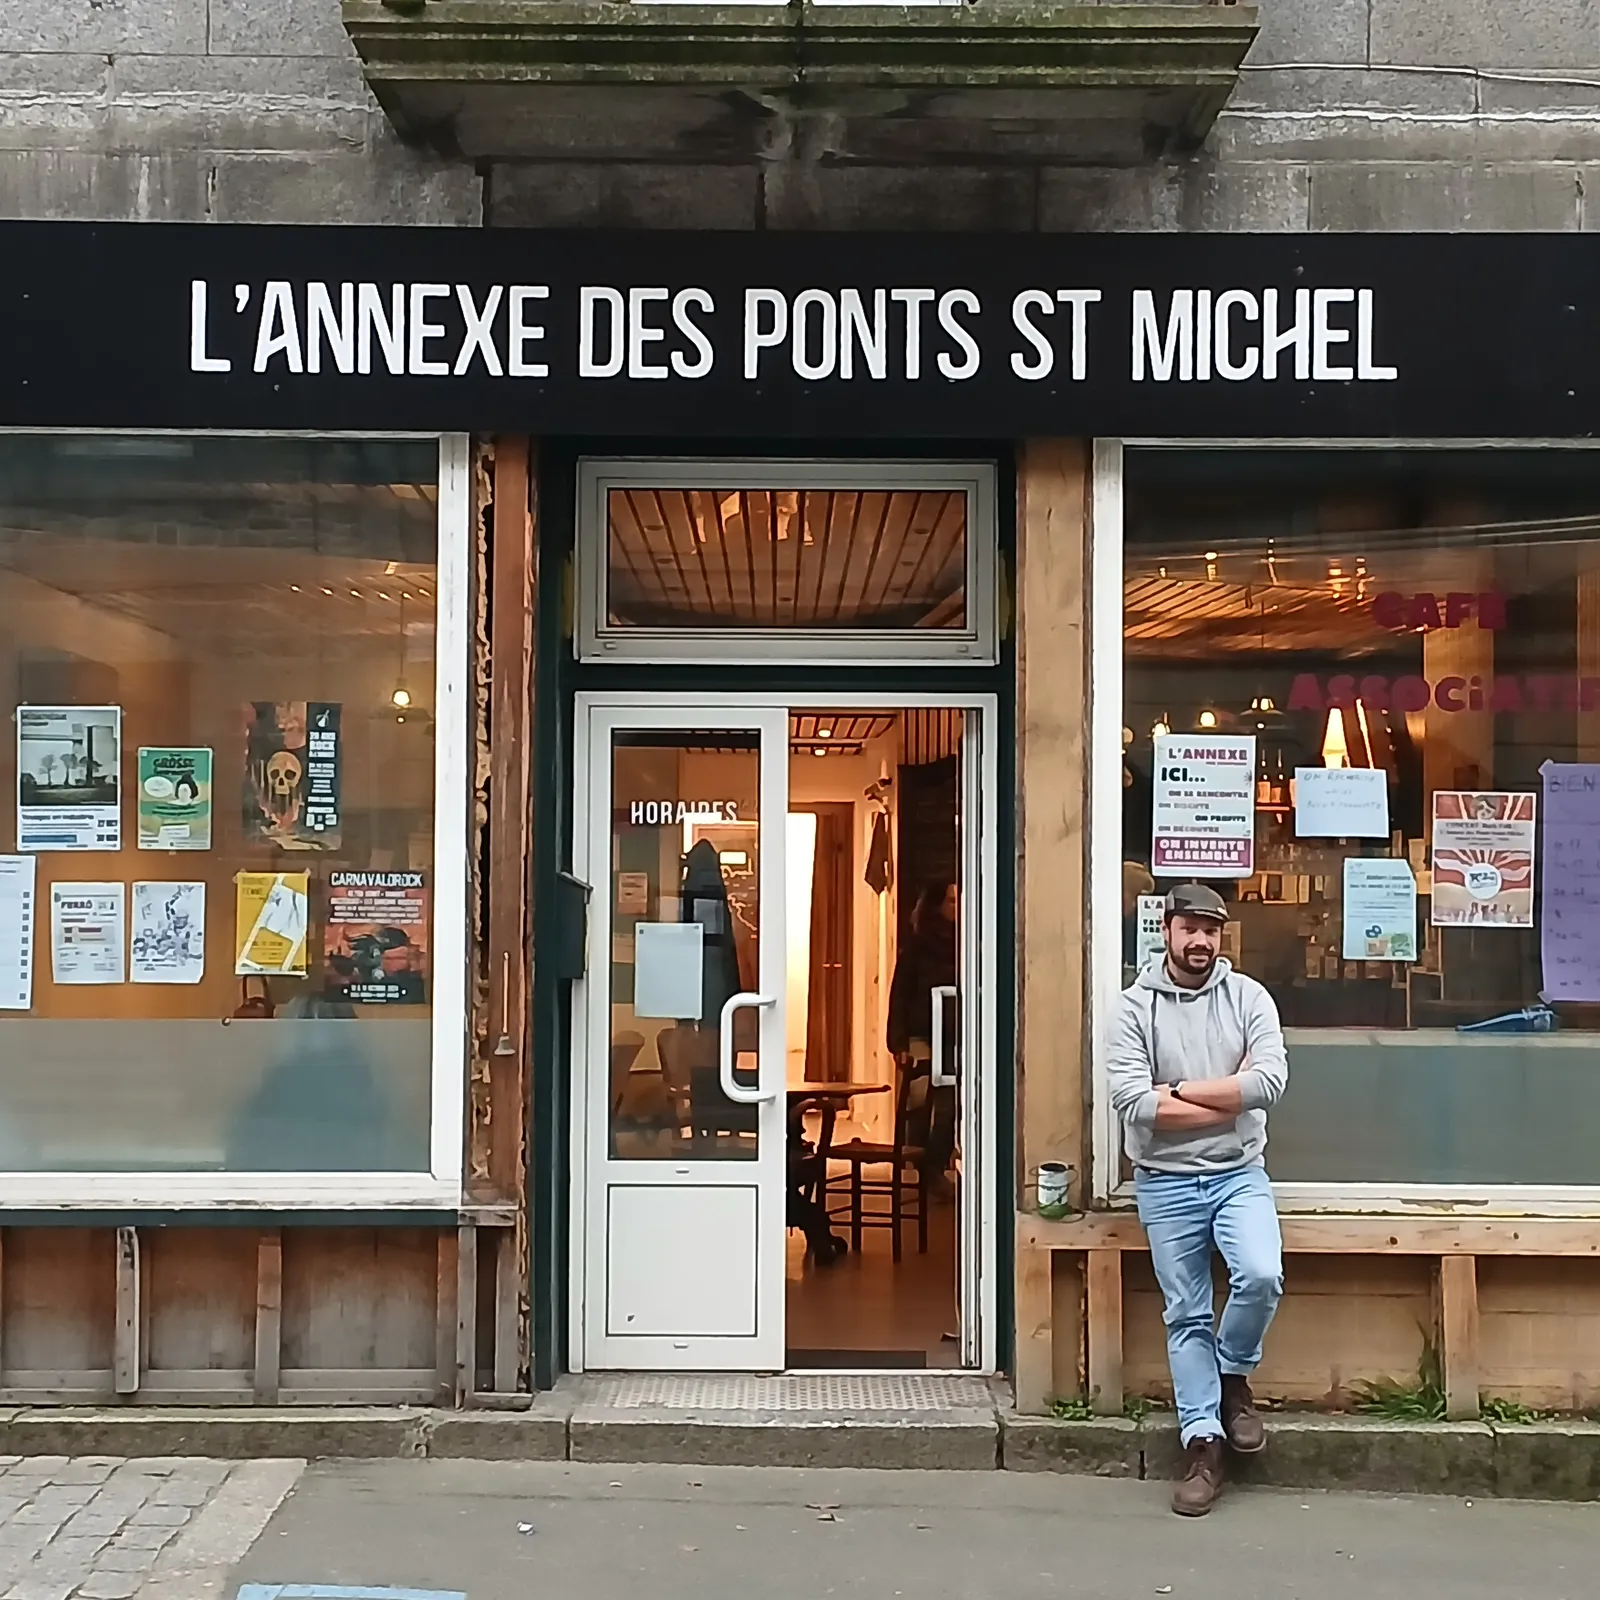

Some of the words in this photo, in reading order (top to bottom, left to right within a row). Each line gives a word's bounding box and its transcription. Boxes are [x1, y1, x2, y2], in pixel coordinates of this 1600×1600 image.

[190, 280, 550, 378] L'ANNEXE
[579, 285, 715, 379] DES
[744, 287, 981, 381] PONTS
[1010, 289, 1102, 381] ST
[1131, 288, 1398, 381] MICHEL
[1168, 747, 1248, 761] L'ANNEXE
[1161, 766, 1206, 783] ICI...
[1158, 838, 1181, 850] ON
[1184, 839, 1246, 852] INVENTE
[1164, 849, 1240, 862] ENSEMBLE
